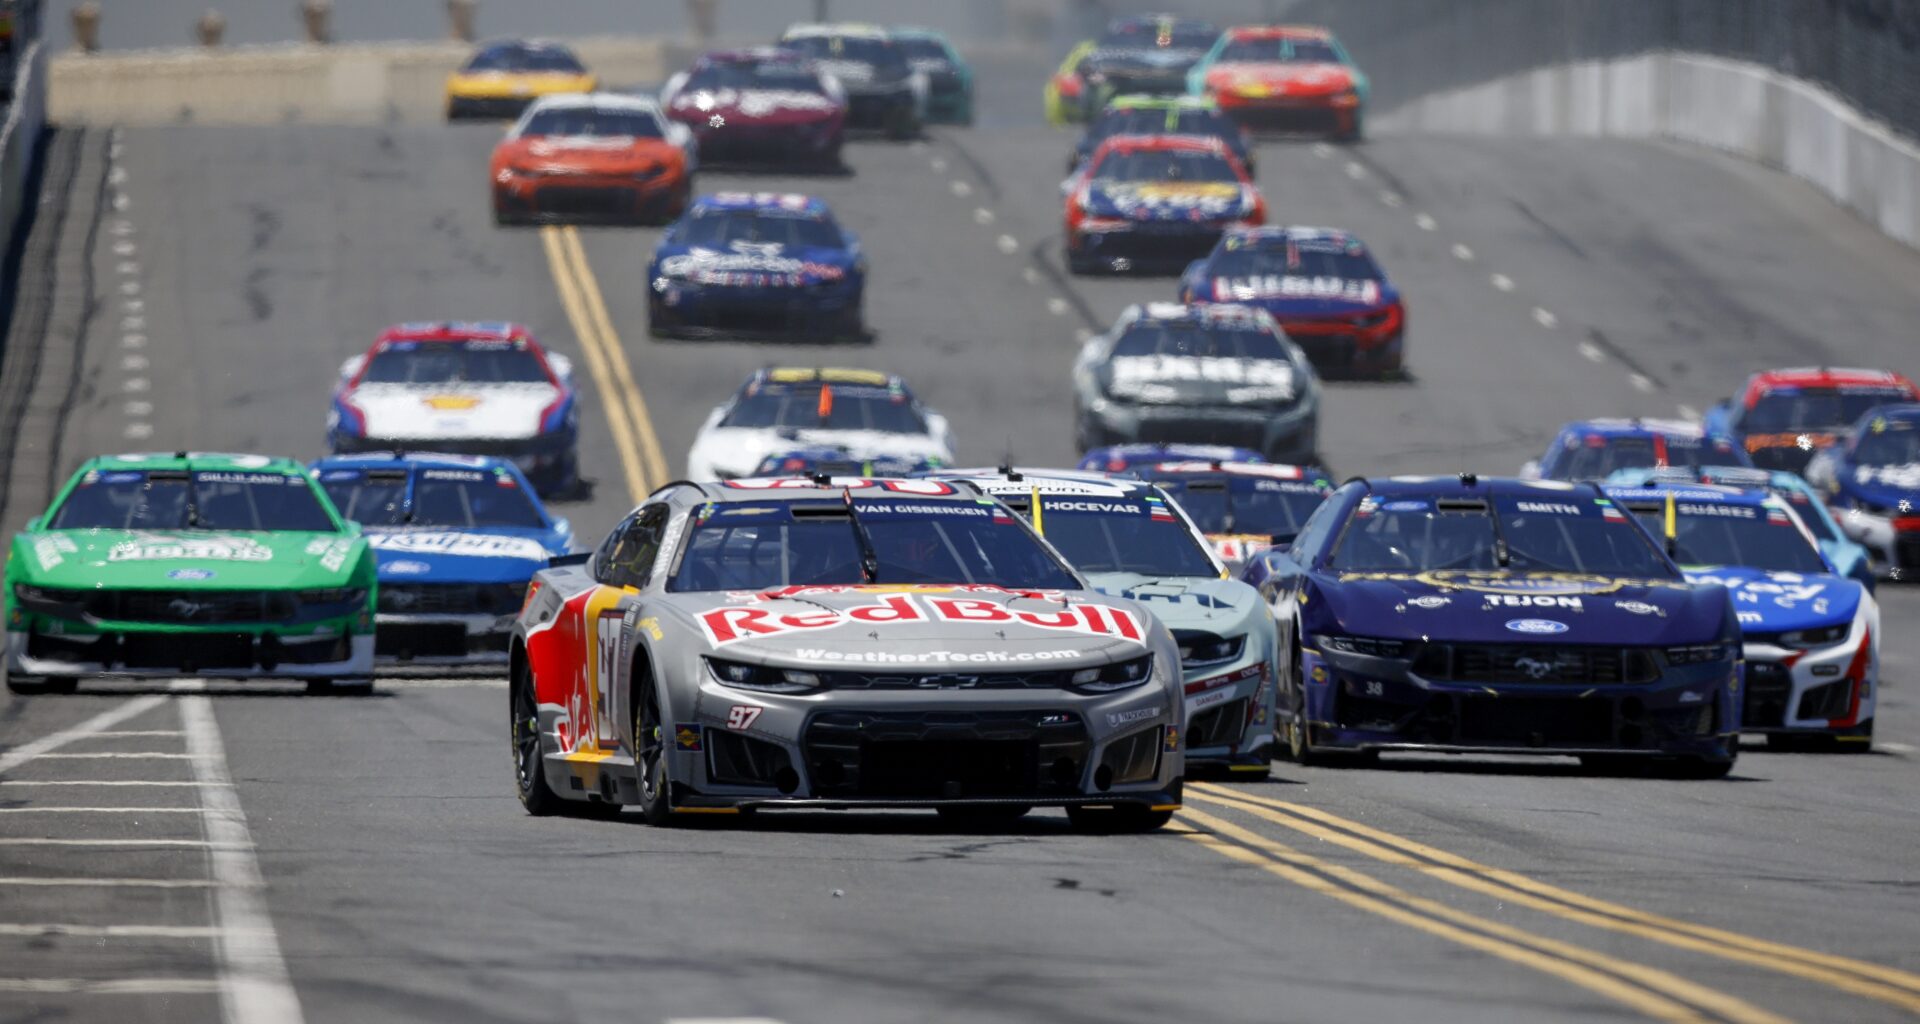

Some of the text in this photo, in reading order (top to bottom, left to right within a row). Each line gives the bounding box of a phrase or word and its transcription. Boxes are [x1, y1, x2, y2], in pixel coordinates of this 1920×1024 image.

[855, 504, 989, 516] VAN GISBERGEN
[1044, 501, 1141, 514] HOCEVAR
[1517, 501, 1581, 515] SMITH
[1484, 594, 1583, 608] TEJON
[697, 592, 927, 645] Red
[927, 598, 1145, 645] Bull
[796, 648, 1081, 663] WeatherTech.com
[1366, 680, 1383, 696] 38
[727, 705, 763, 731] 97
